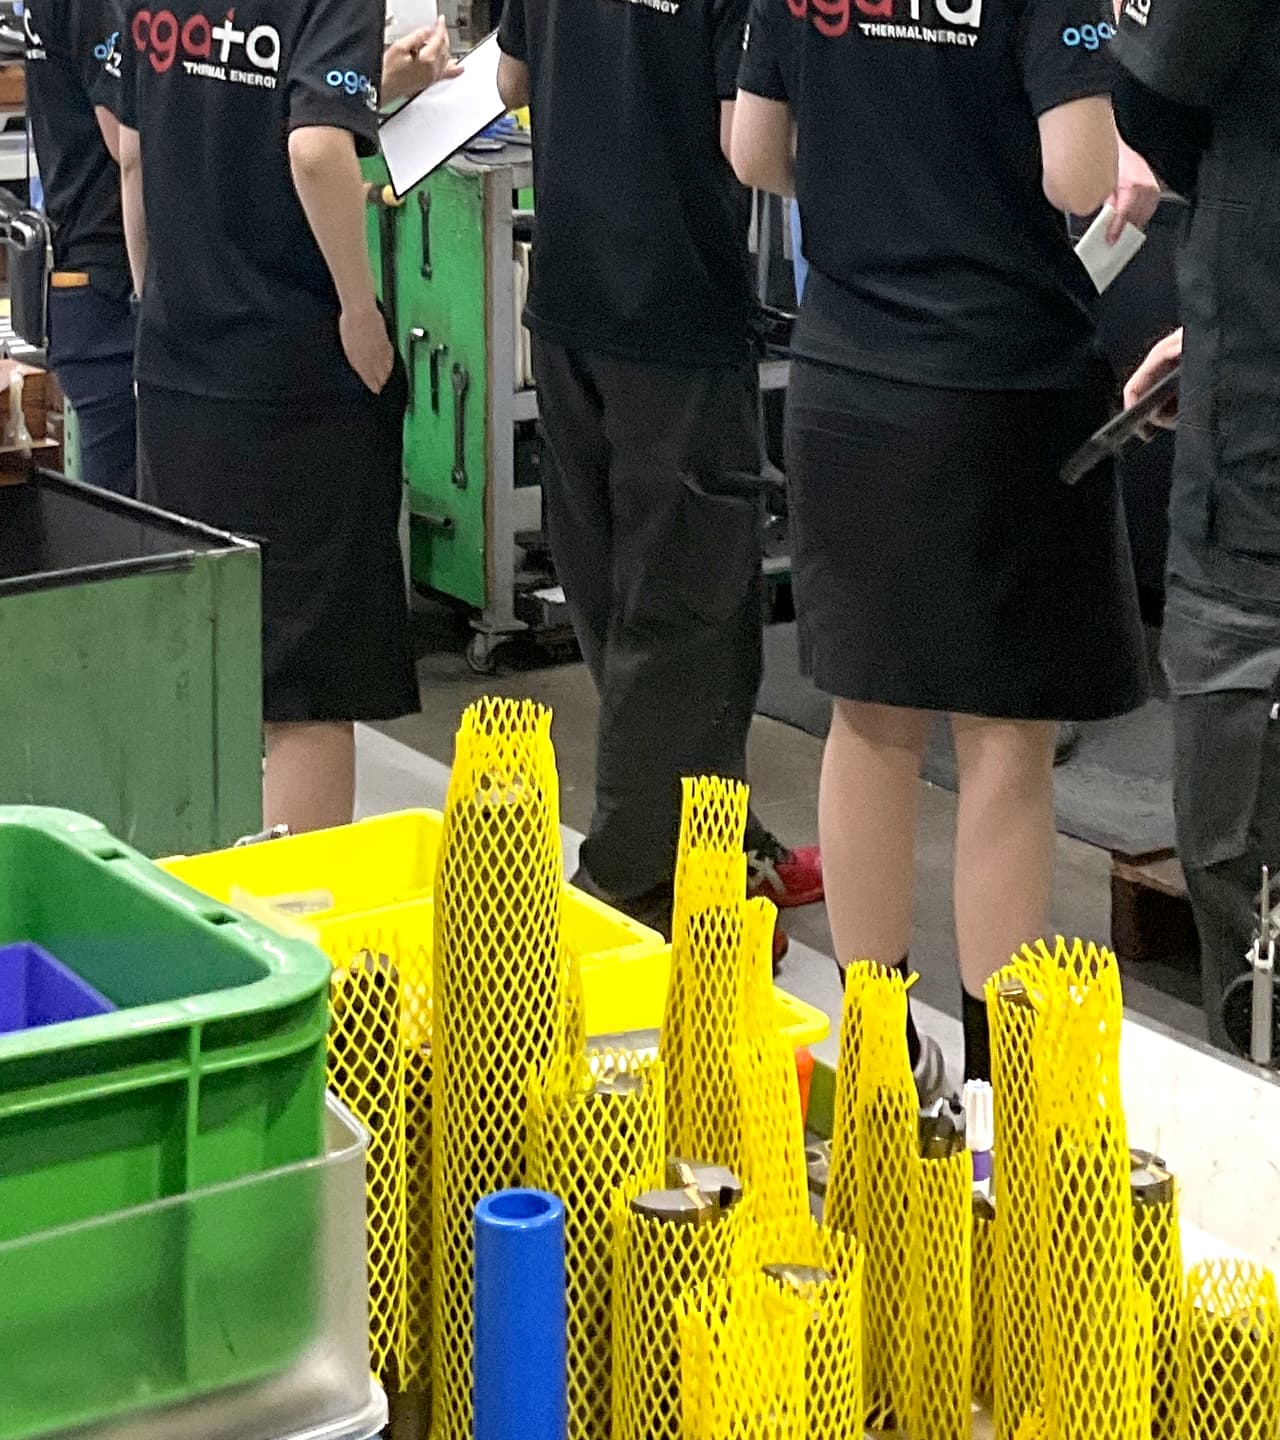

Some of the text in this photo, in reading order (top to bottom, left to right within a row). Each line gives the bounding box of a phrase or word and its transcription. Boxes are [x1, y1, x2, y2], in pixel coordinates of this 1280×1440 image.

[131, 7, 281, 74] ogata
[858, 23, 922, 40] THERMAL
[1063, 22, 1117, 51] oga
[230, 69, 277, 89] ENERGY
